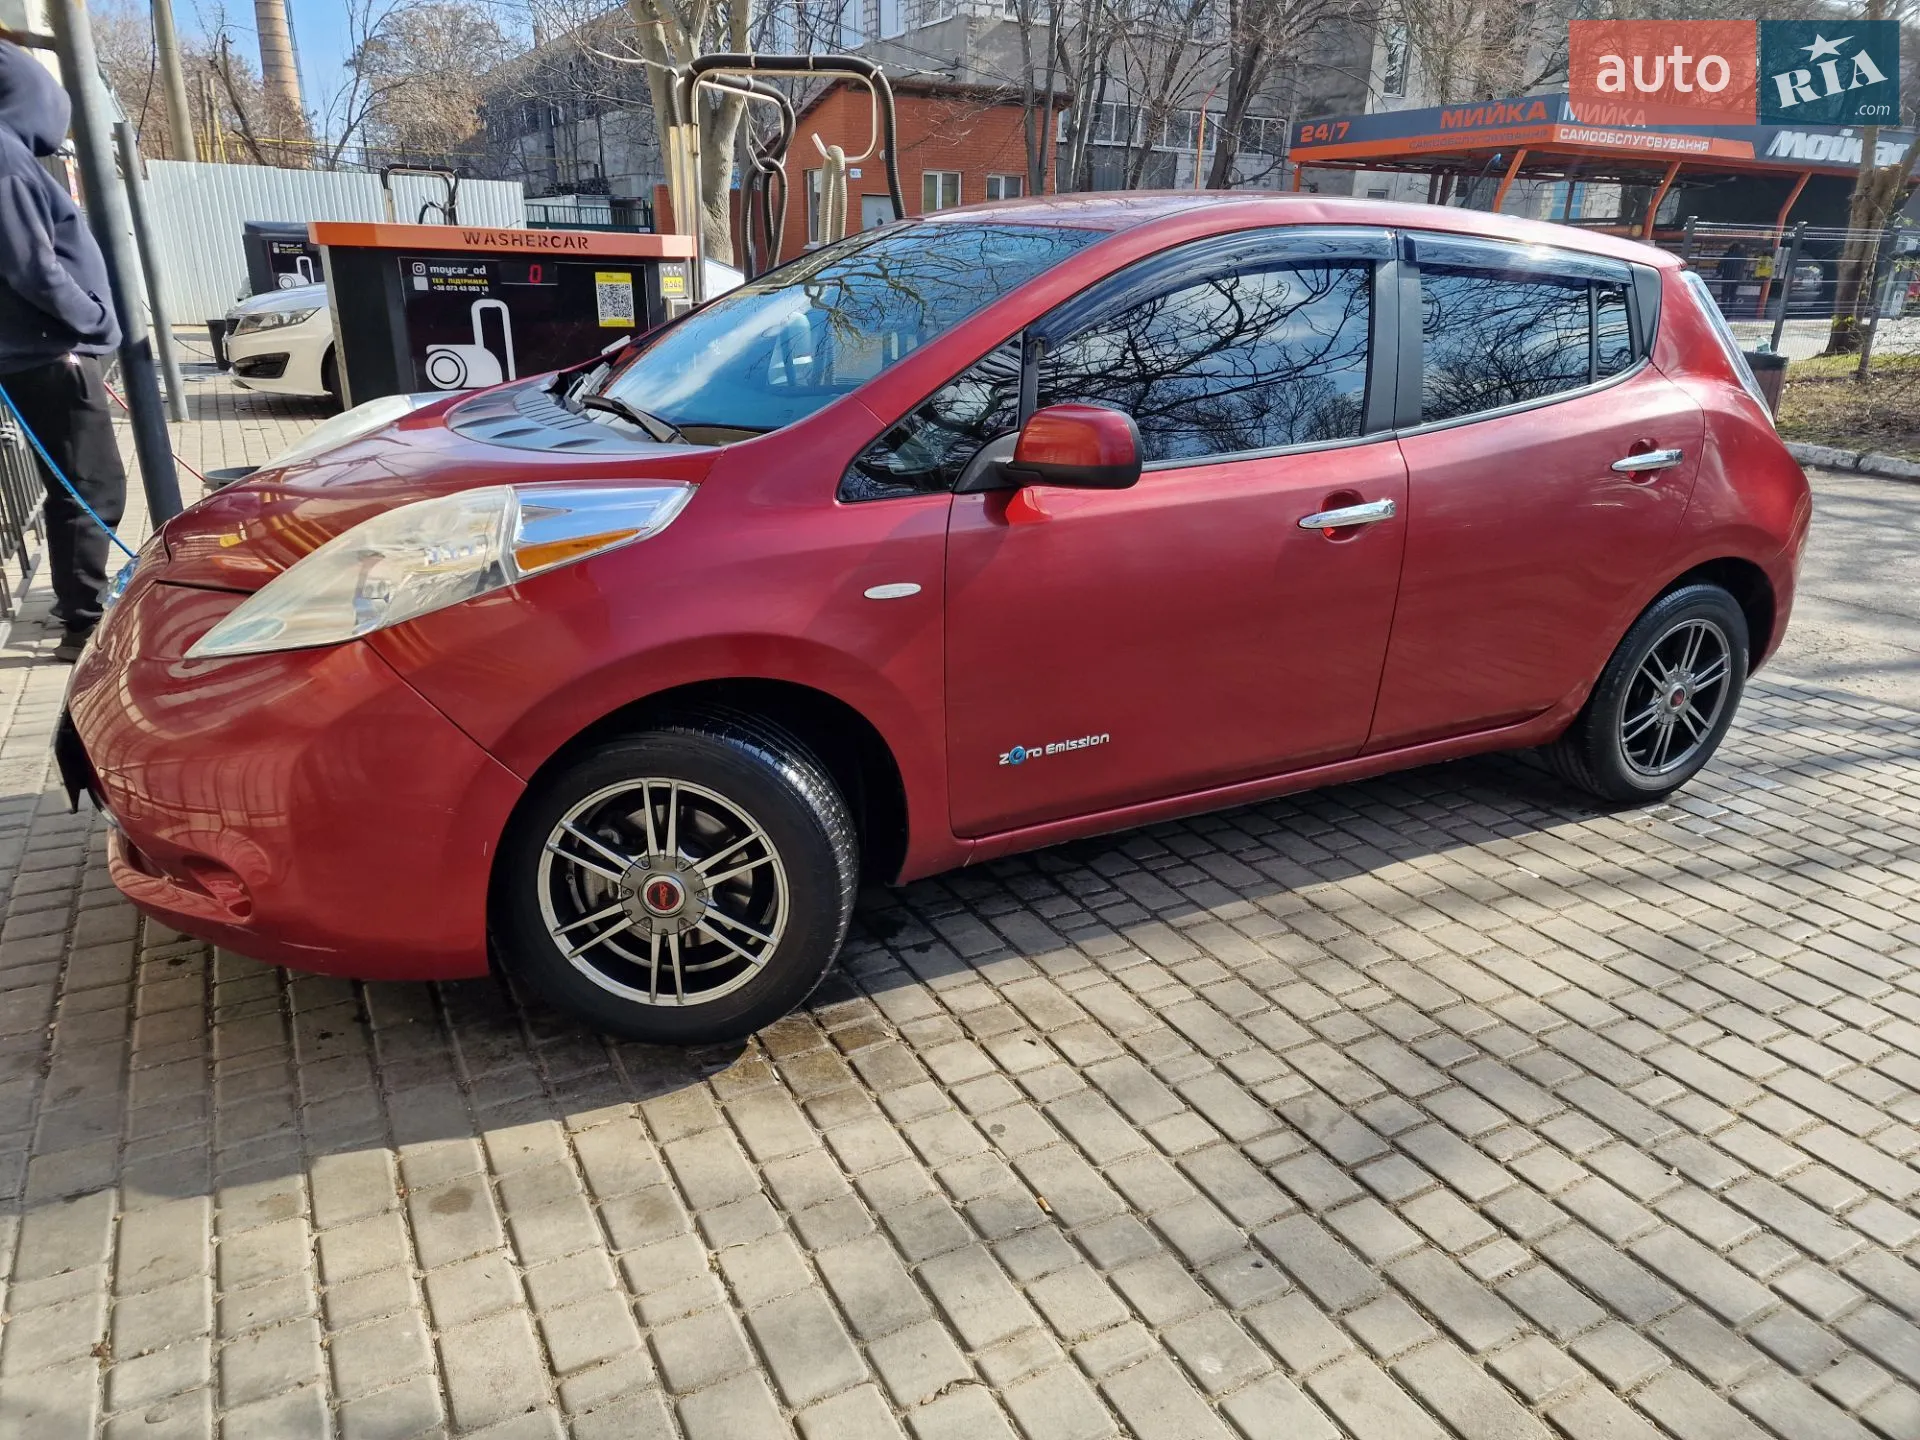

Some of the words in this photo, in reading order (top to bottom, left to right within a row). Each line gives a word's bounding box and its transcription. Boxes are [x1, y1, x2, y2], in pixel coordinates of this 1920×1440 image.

[1440, 100, 1547, 129] МИЙКА
[1563, 101, 1646, 128] МИЙКА
[1300, 121, 1350, 143] 24/7
[1560, 128, 1710, 151] САМООБСЛУГОВУВАННЯ
[463, 231, 589, 250] WASHERCAR
[429, 264, 487, 277] moycar_od
[529, 264, 542, 284] 0
[999, 745, 1042, 765] zero
[1045, 733, 1110, 755] Emission
